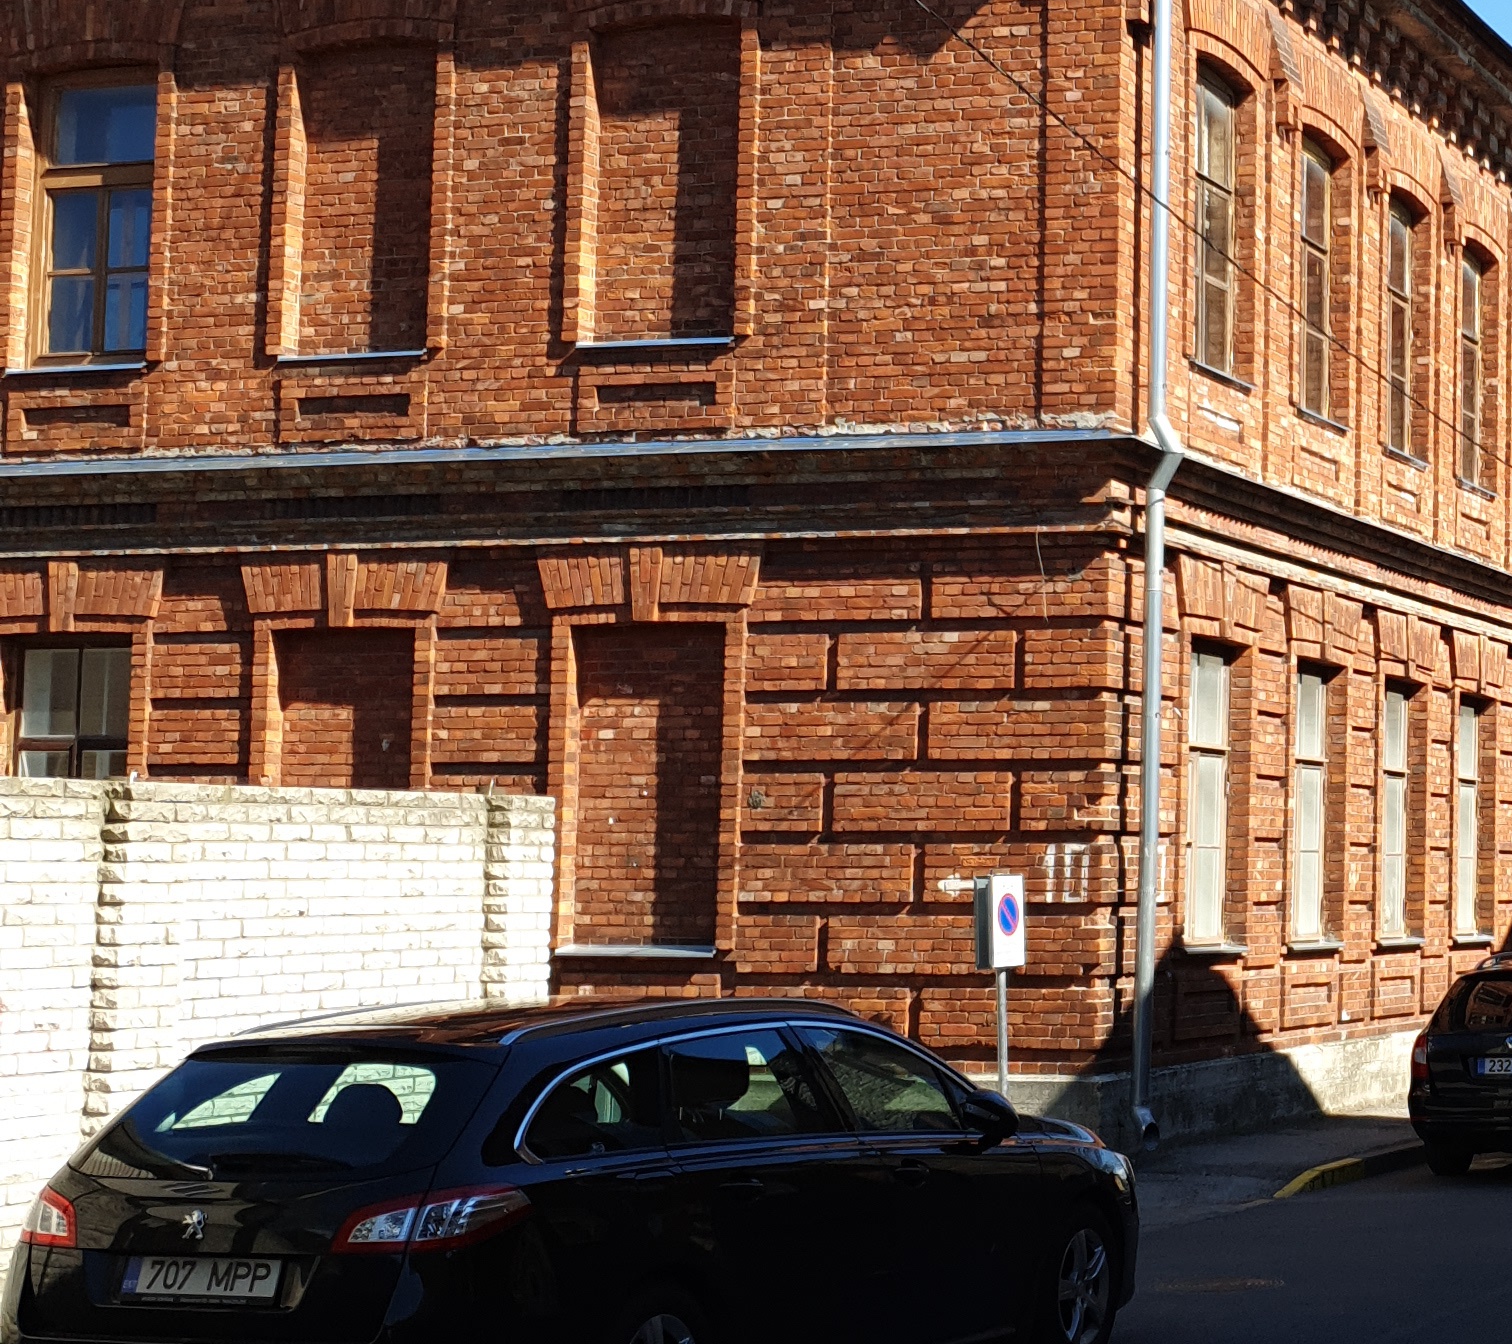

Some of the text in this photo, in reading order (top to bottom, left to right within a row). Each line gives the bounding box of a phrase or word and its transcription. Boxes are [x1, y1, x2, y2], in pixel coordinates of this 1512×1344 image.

[1488, 1060, 1511, 1072] 232
[146, 1260, 271, 1293] 707 MPP
